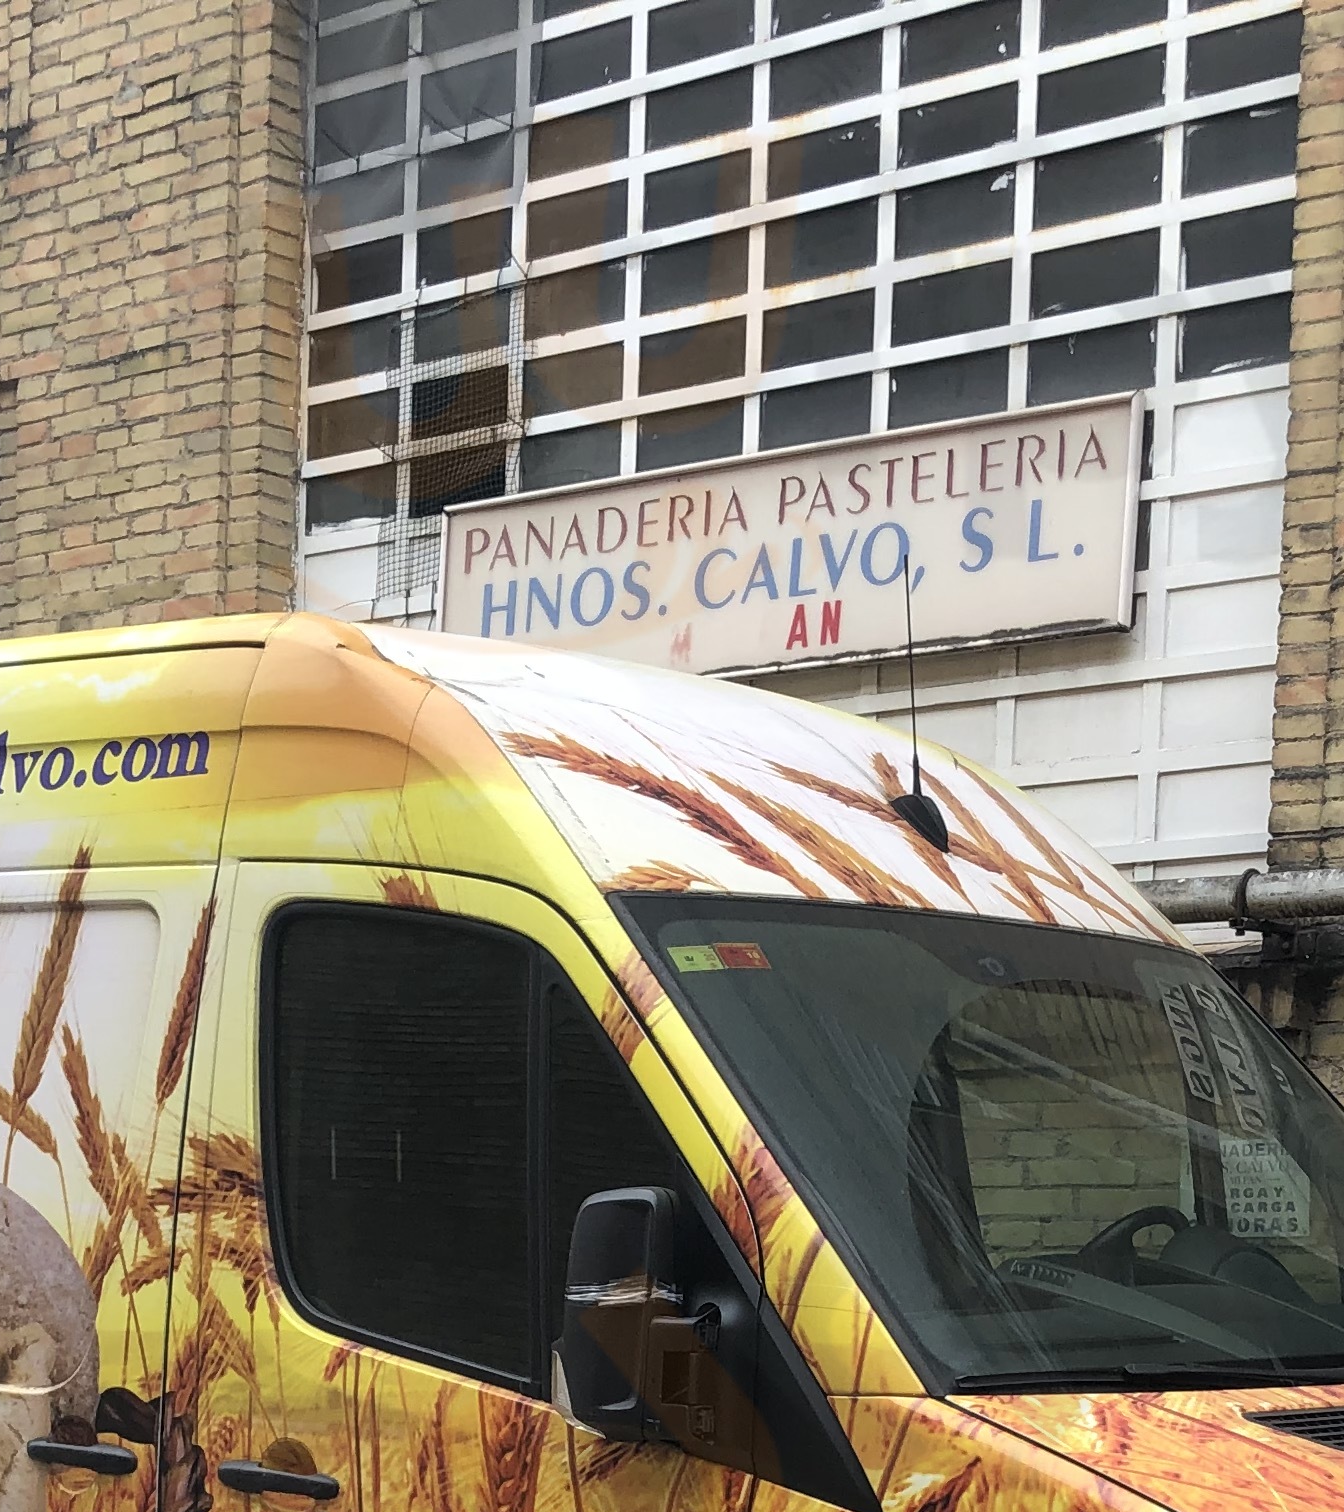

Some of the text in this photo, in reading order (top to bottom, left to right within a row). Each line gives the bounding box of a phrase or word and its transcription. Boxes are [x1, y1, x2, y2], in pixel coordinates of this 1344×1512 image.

[464, 424, 1108, 574] PANADERIA PASTELERIA
[481, 562, 667, 638] HNOS.
[695, 522, 925, 610] CALVO,
[1229, 1187, 1269, 1199] RGA
[1230, 1201, 1296, 1214] CARGA
